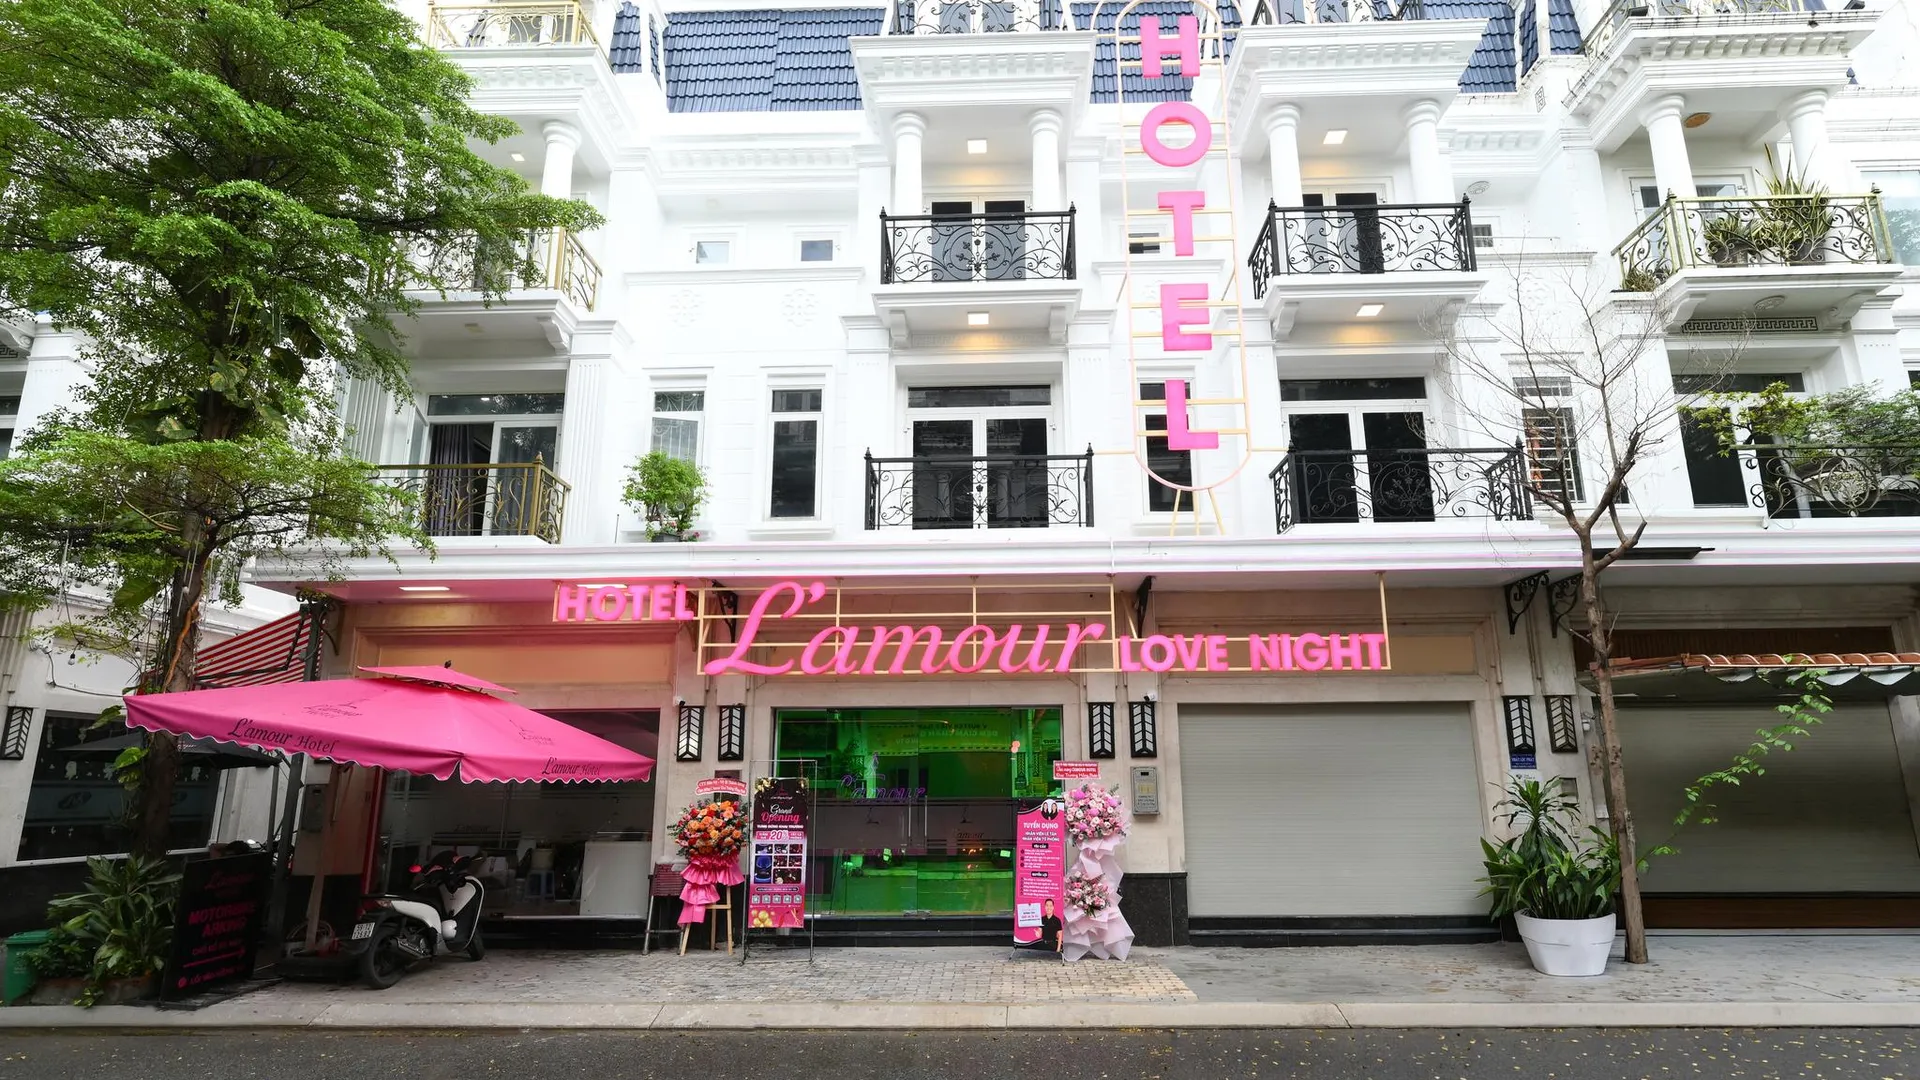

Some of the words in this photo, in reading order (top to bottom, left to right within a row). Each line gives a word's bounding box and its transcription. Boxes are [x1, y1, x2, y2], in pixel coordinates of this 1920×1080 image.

[1140, 15, 1219, 450] HOTEL
[556, 584, 694, 621] HOTEL
[703, 580, 1107, 676] L'amour
[1118, 633, 1229, 673] LOVE
[1248, 632, 1387, 672] NIGHT
[228, 718, 294, 745] L'amour
[293, 735, 340, 754] Hotel
[541, 756, 580, 775] L'amour
[761, 812, 800, 824] Opening
[770, 804, 794, 816] Grand
